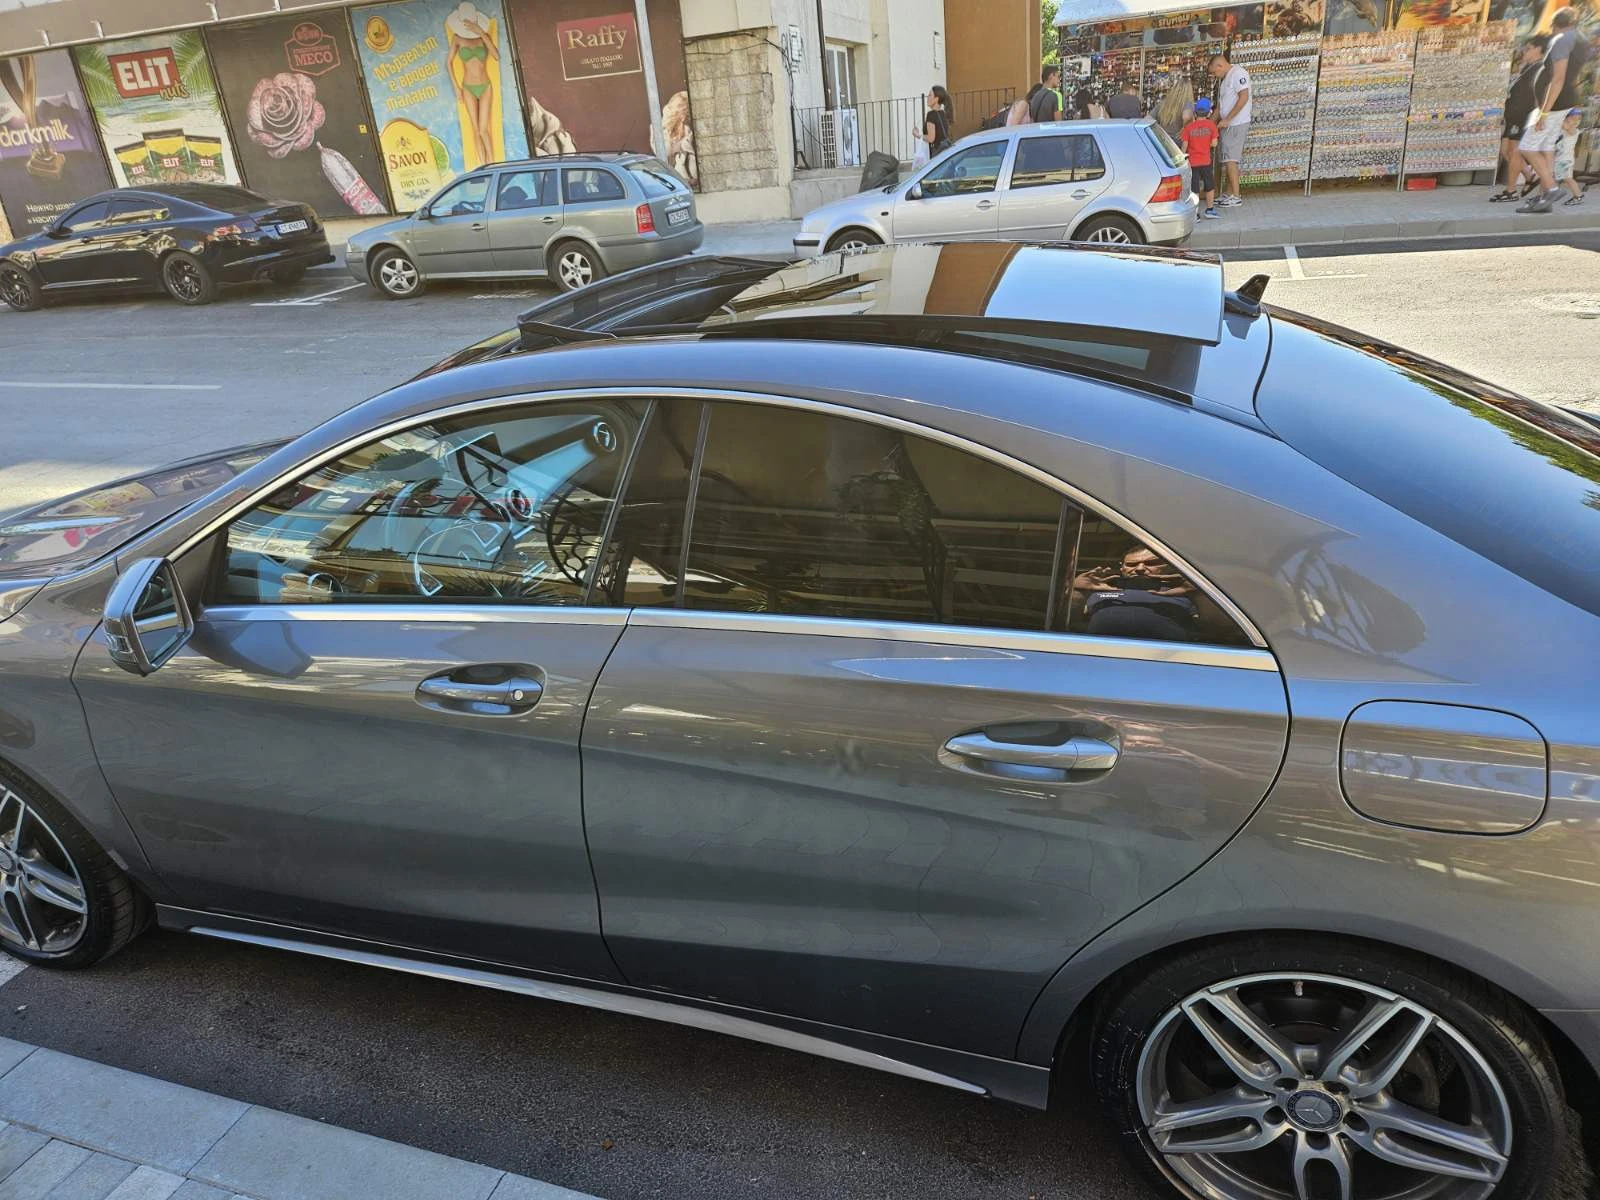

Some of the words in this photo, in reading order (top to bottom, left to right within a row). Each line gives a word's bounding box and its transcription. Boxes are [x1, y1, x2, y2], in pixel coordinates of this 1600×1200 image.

[564, 24, 628, 50] Raffy
[160, 80, 190, 100] nuts
[386, 85, 438, 112] талант
[0, 119, 75, 147] darkmilk
[389, 151, 428, 170] SAVOY
